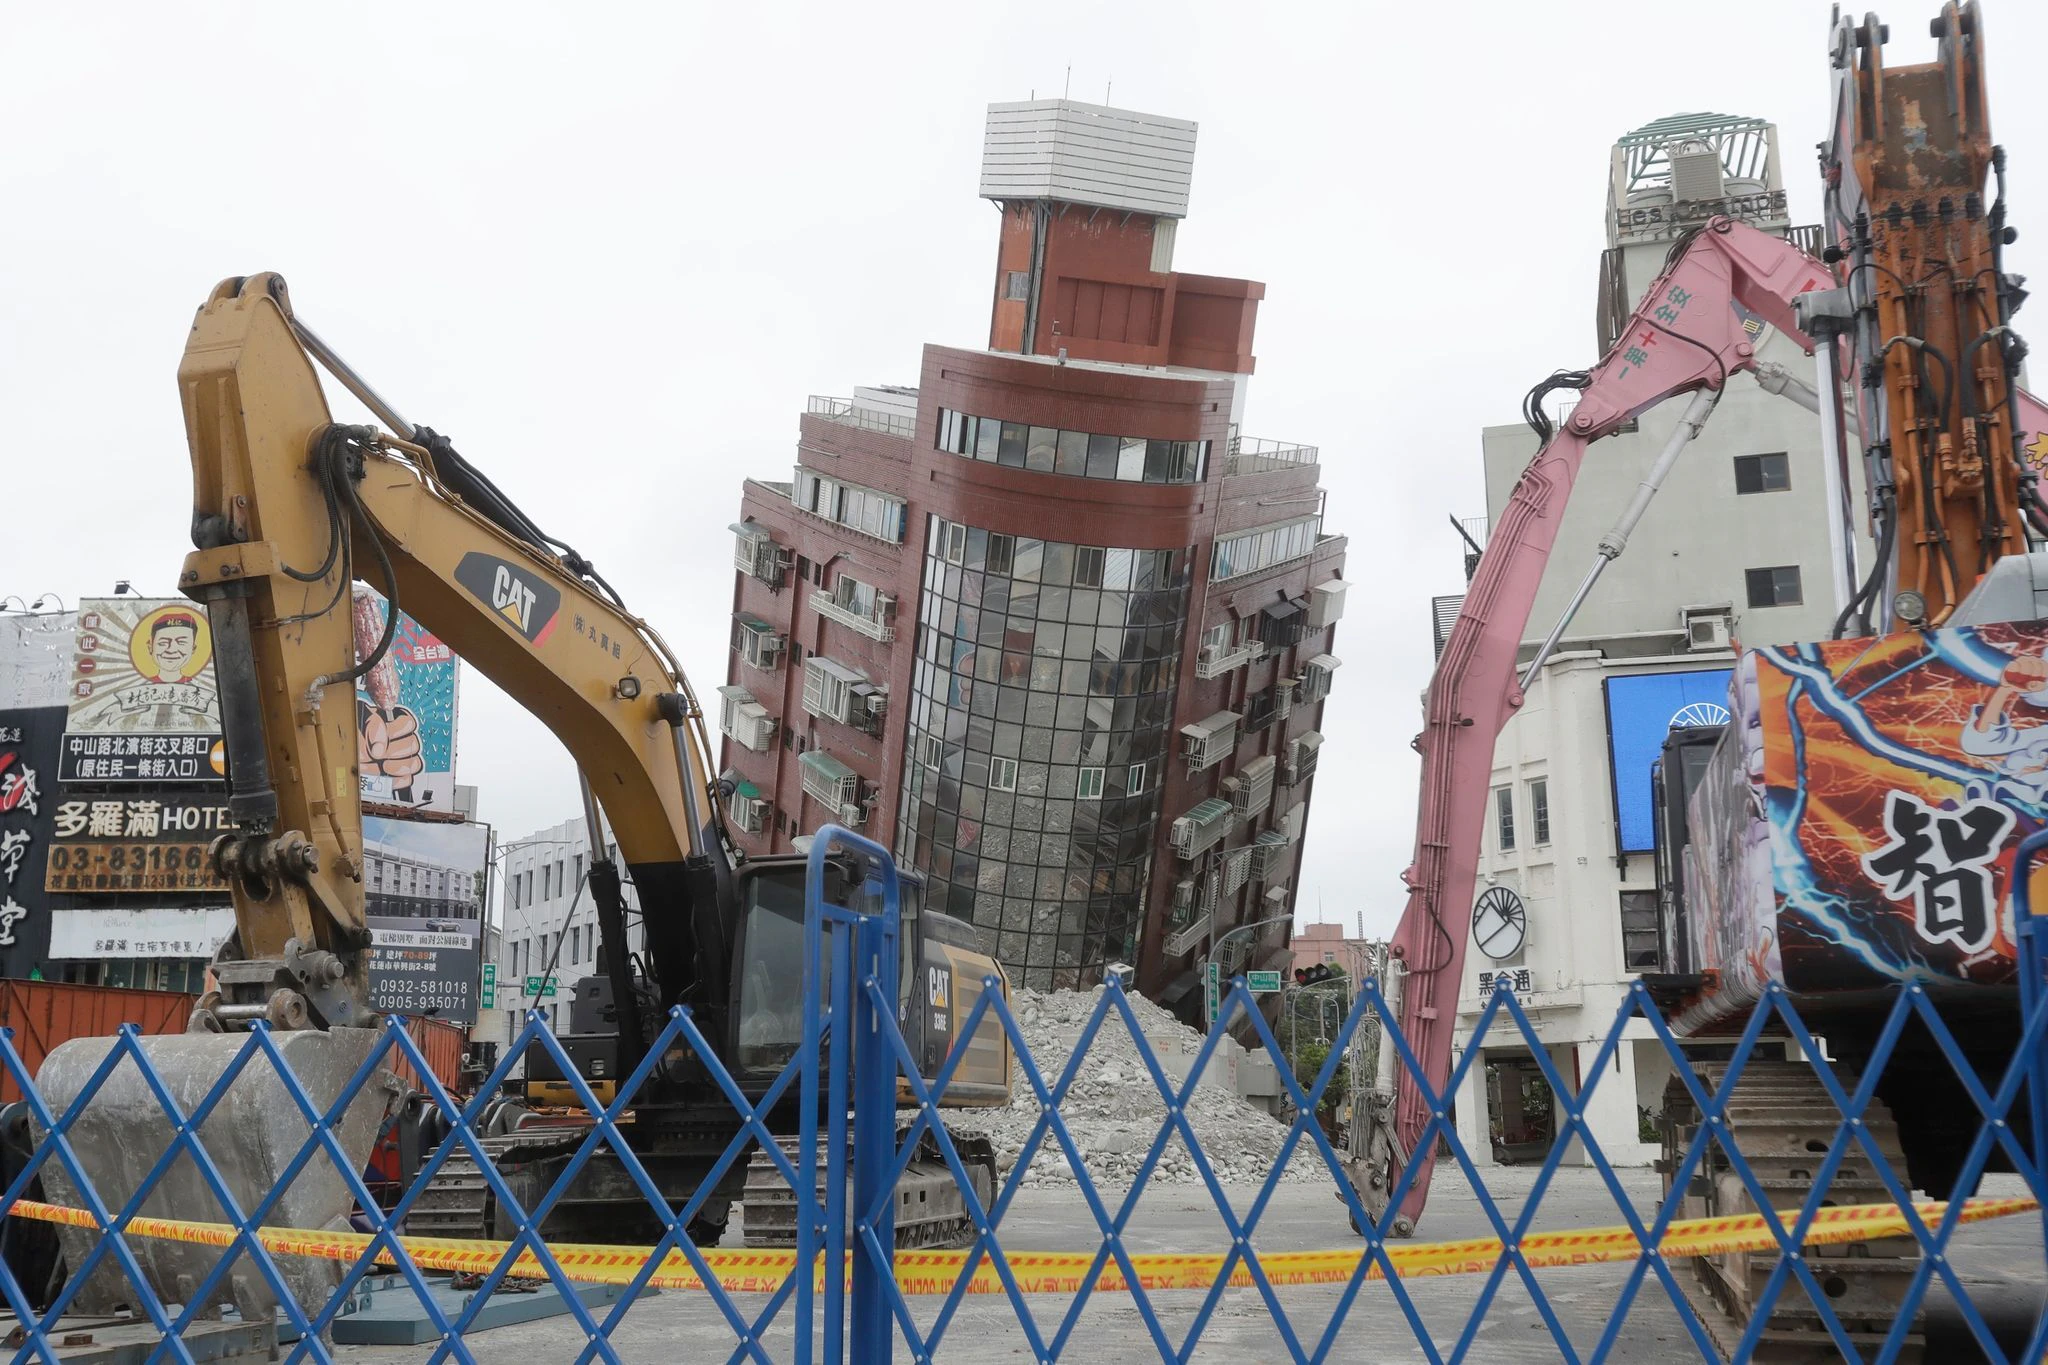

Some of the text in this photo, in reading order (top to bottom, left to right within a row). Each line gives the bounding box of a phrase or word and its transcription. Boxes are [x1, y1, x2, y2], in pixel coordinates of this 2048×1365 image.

[492, 565, 536, 632] CAT
[78, 615, 99, 696] 僅此一家
[70, 737, 209, 755] 中山路北濱街交叉路口
[75, 757, 198, 777] (原住民一條街入口)
[54, 800, 161, 837] 多羅滿
[1869, 795, 2009, 946] 智
[379, 995, 466, 1009] 0905-935071
[380, 979, 468, 994] 0932-581018
[929, 966, 949, 1009] CAT
